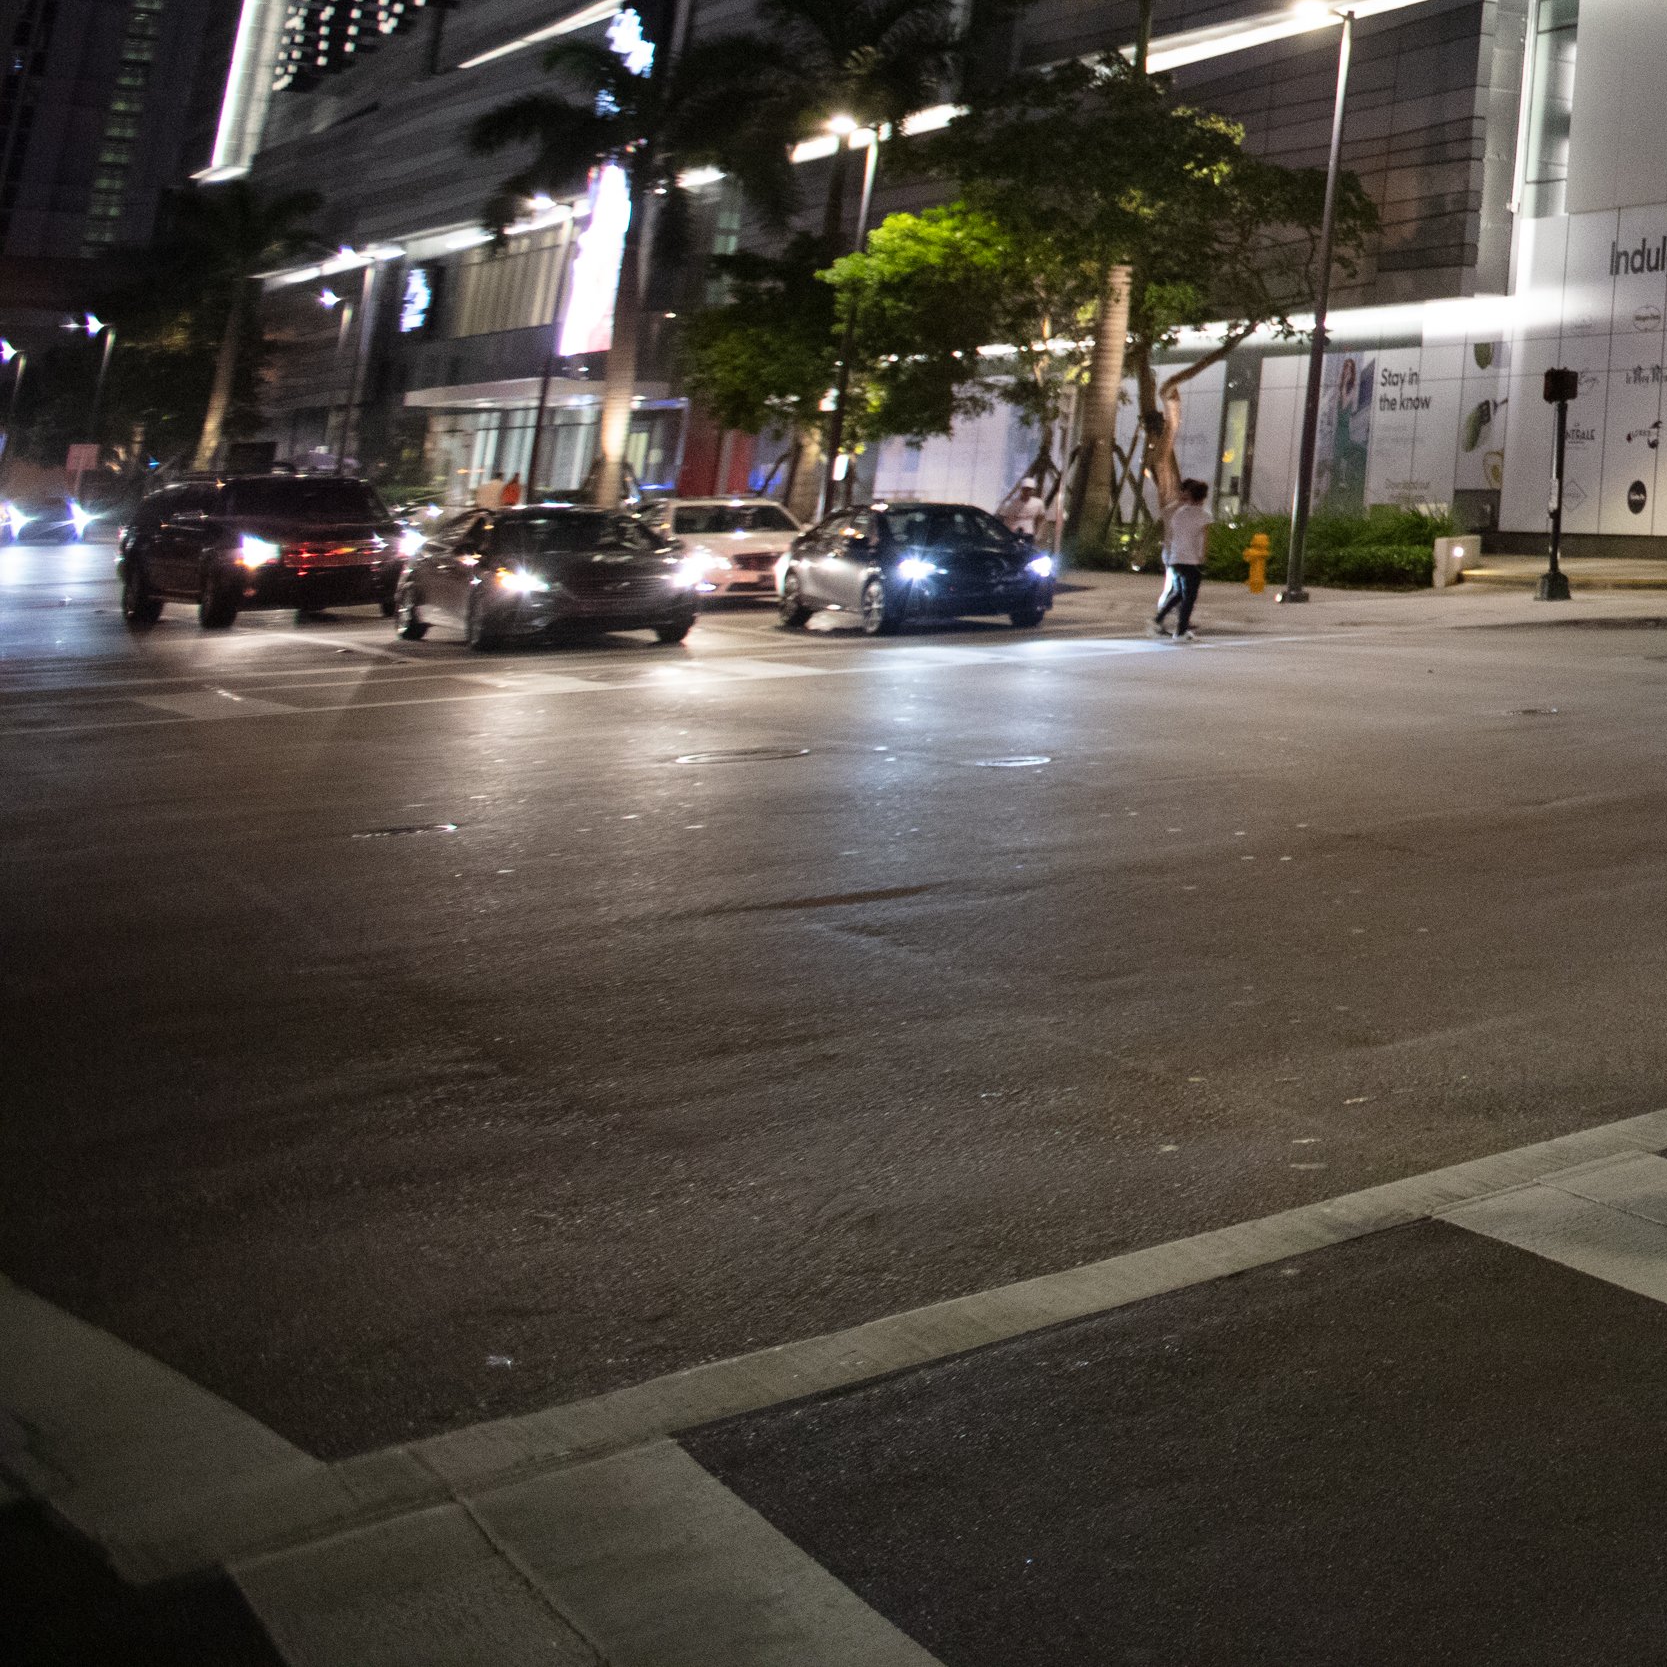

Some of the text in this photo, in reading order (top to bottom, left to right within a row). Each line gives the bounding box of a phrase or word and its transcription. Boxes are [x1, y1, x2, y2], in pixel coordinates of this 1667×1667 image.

[1380, 367, 1419, 387] Stay in
[1379, 393, 1431, 411] the know
